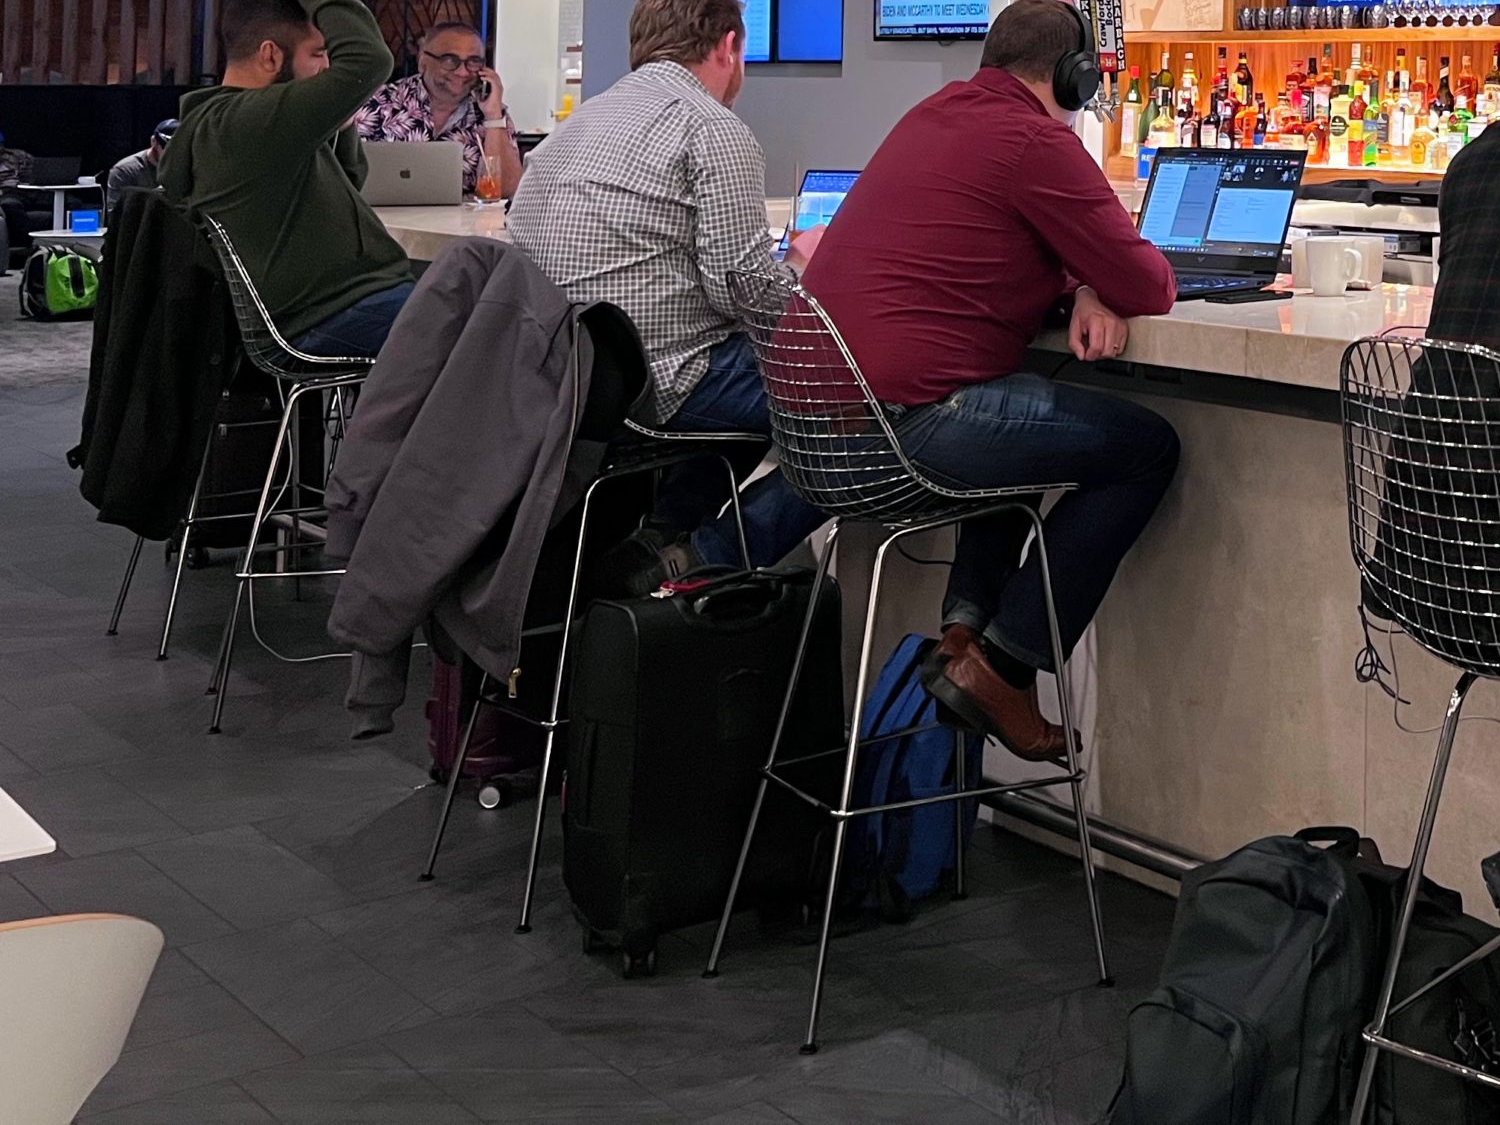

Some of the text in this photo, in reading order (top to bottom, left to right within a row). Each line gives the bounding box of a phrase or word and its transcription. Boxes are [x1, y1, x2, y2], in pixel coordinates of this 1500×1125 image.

[882, 5, 896, 17] BIDEN
[897, 5, 906, 17] AND
[941, 4, 955, 16] MEET
[956, 3, 986, 16] WEDNESDAY
